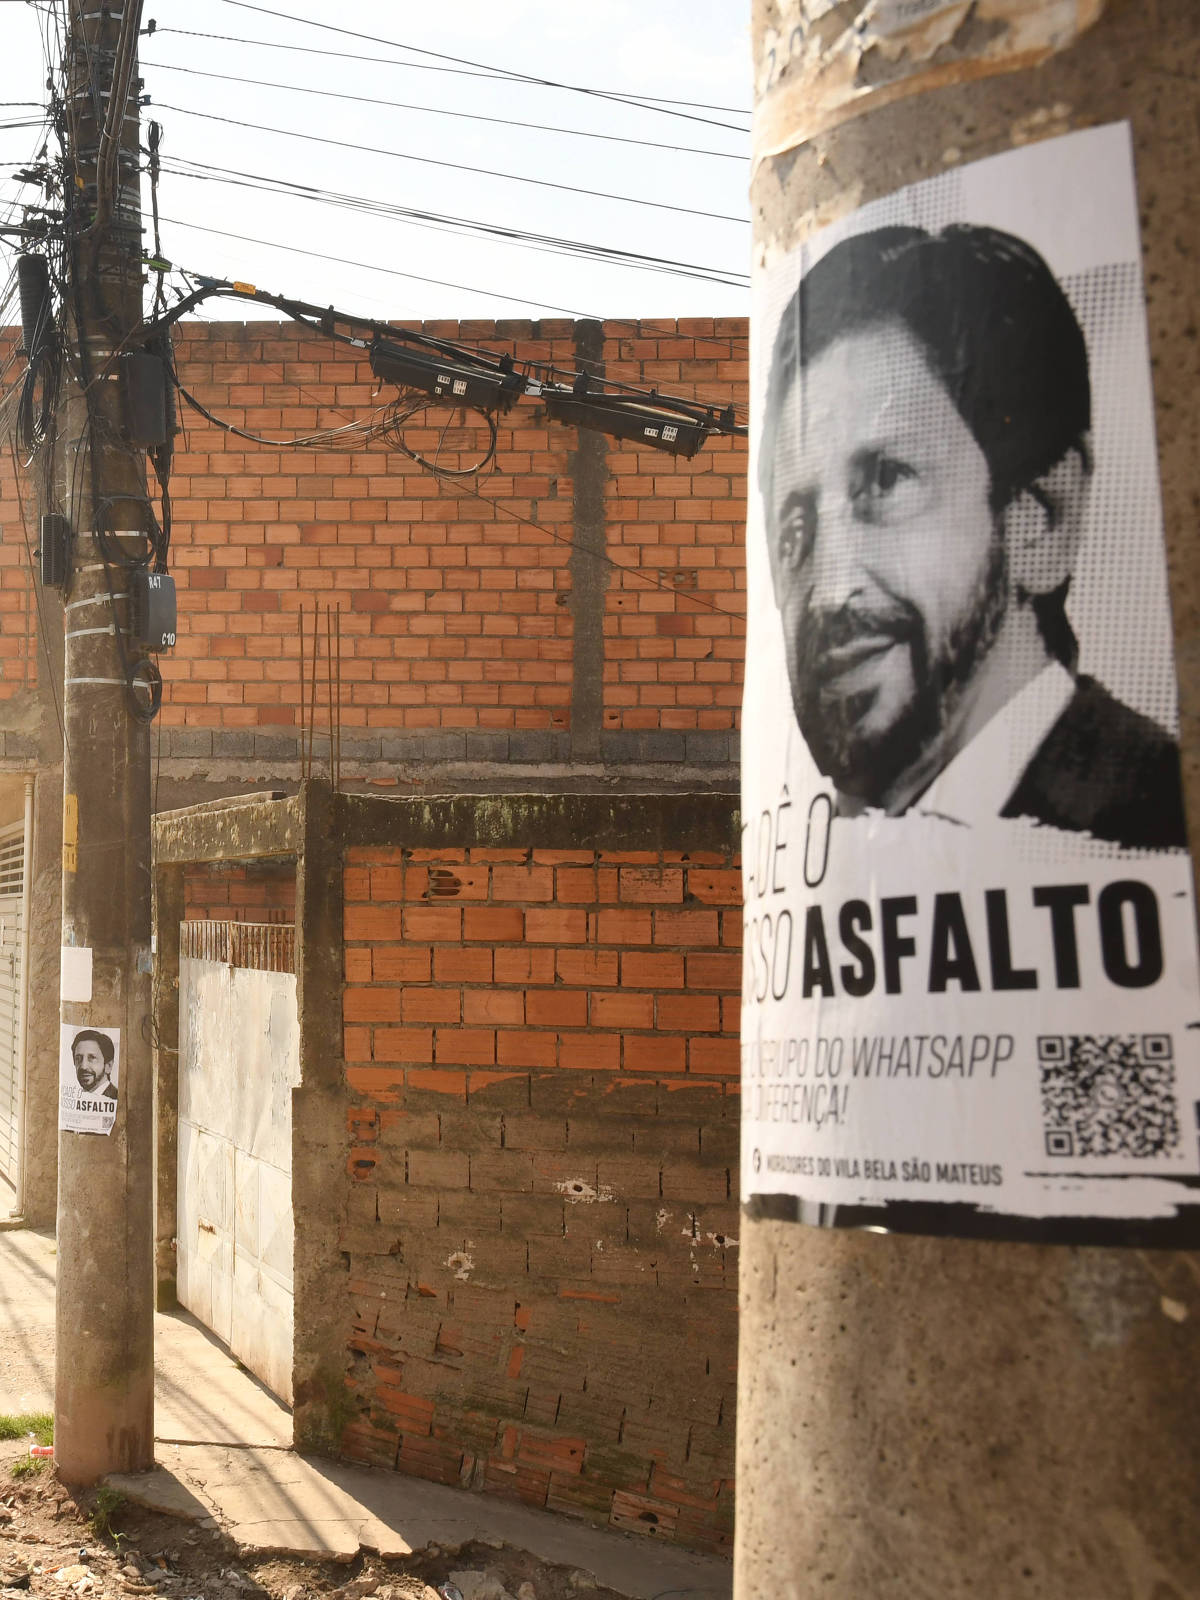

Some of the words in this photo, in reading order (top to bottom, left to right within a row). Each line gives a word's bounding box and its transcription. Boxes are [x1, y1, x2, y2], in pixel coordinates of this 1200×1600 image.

[148, 576, 161, 589] R47
[161, 632, 176, 646] C10
[803, 792, 833, 889] O
[802, 879, 1164, 999] ASFALTO
[814, 1037, 844, 1078] DO
[852, 1034, 1014, 1078] WHATSAPP
[76, 1100, 115, 1113] ASFALTO
[818, 1157, 832, 1177] DO
[833, 1158, 859, 1179] VILA
[864, 1159, 899, 1182] BELA
[902, 1157, 931, 1183] SÃO
[936, 1162, 1004, 1187] MATEUS
